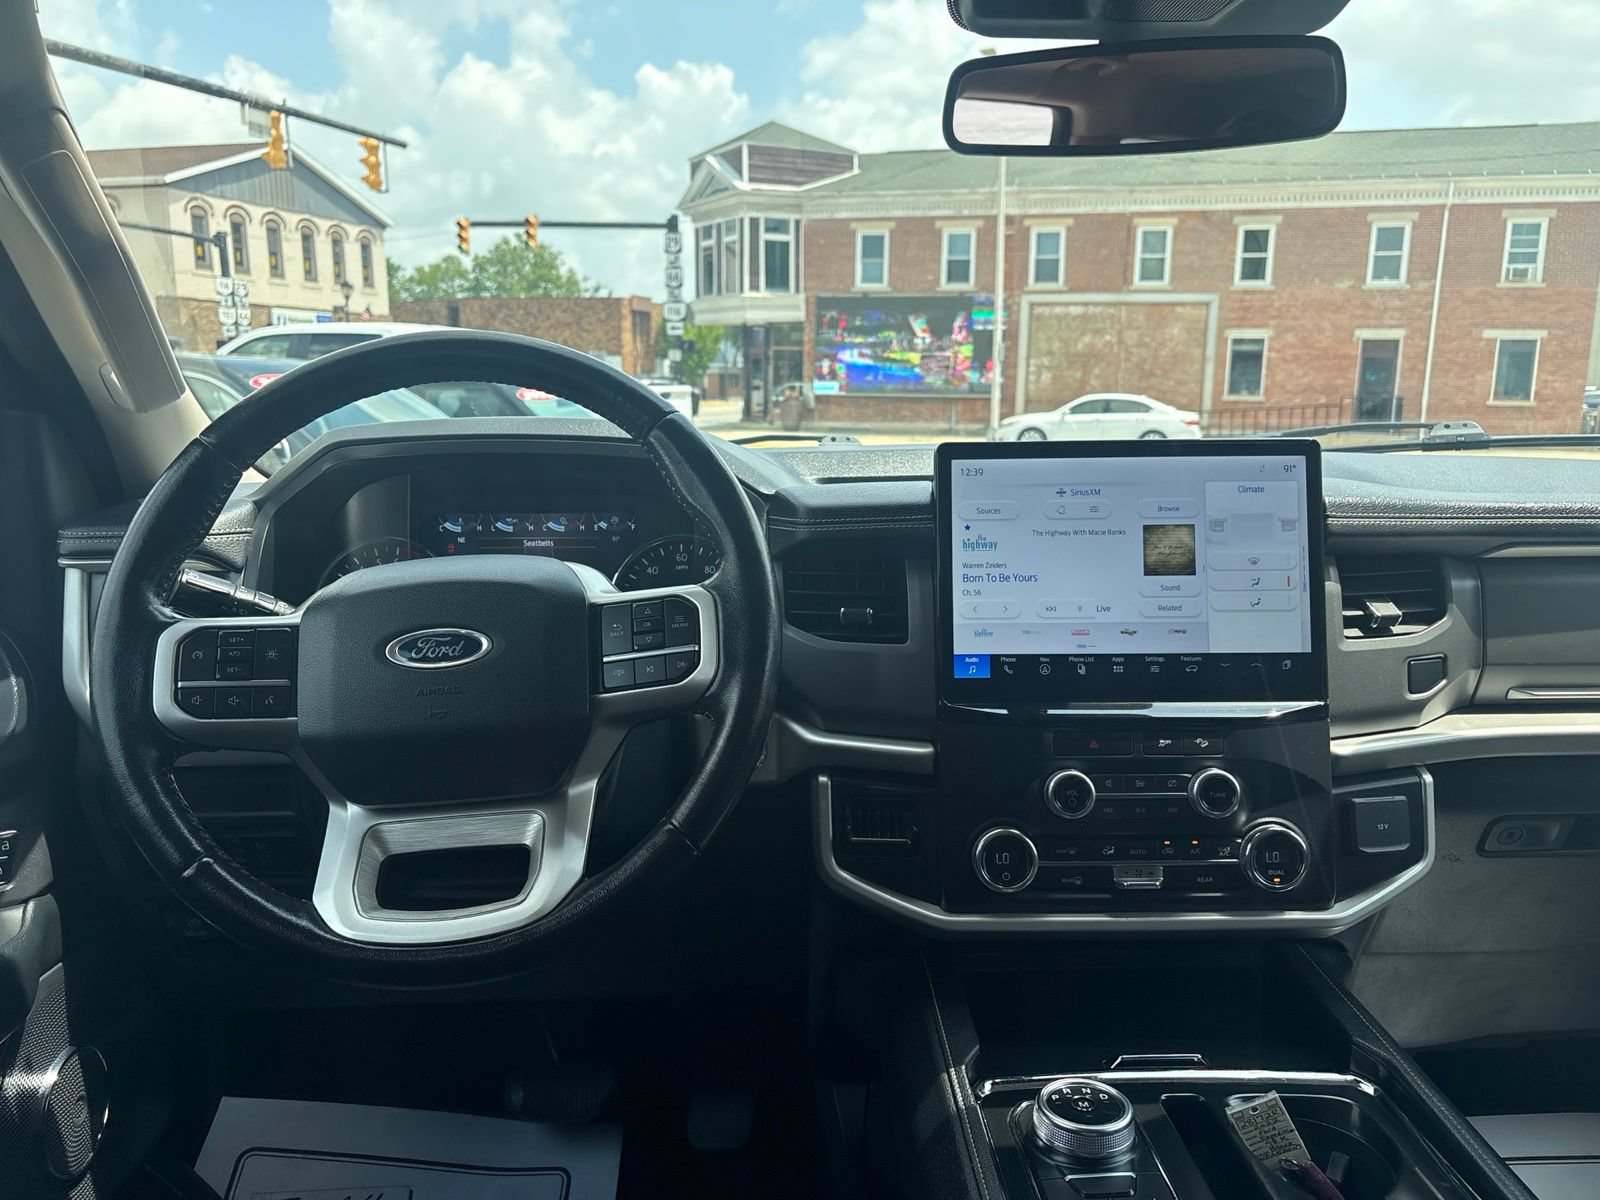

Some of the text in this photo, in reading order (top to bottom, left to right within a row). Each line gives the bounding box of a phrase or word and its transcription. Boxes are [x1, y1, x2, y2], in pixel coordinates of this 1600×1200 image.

[960, 468, 984, 477] 12:39
[1283, 464, 1297, 473] 91°
[1070, 488, 1101, 497] SiriusXM
[1237, 485, 1265, 493] Climate
[976, 507, 1001, 515] Sources
[1032, 528, 1126, 538] The Highway With Macie Banks
[962, 538, 998, 551] highway
[676, 553, 688, 562] 60
[646, 566, 659, 574] 40
[704, 565, 716, 574] 80
[962, 573, 1038, 583] Born To Be Yours
[1160, 584, 1181, 592] Sound
[1096, 605, 1111, 613] Live
[1157, 604, 1182, 612] Related
[412, 636, 465, 659] Ford
